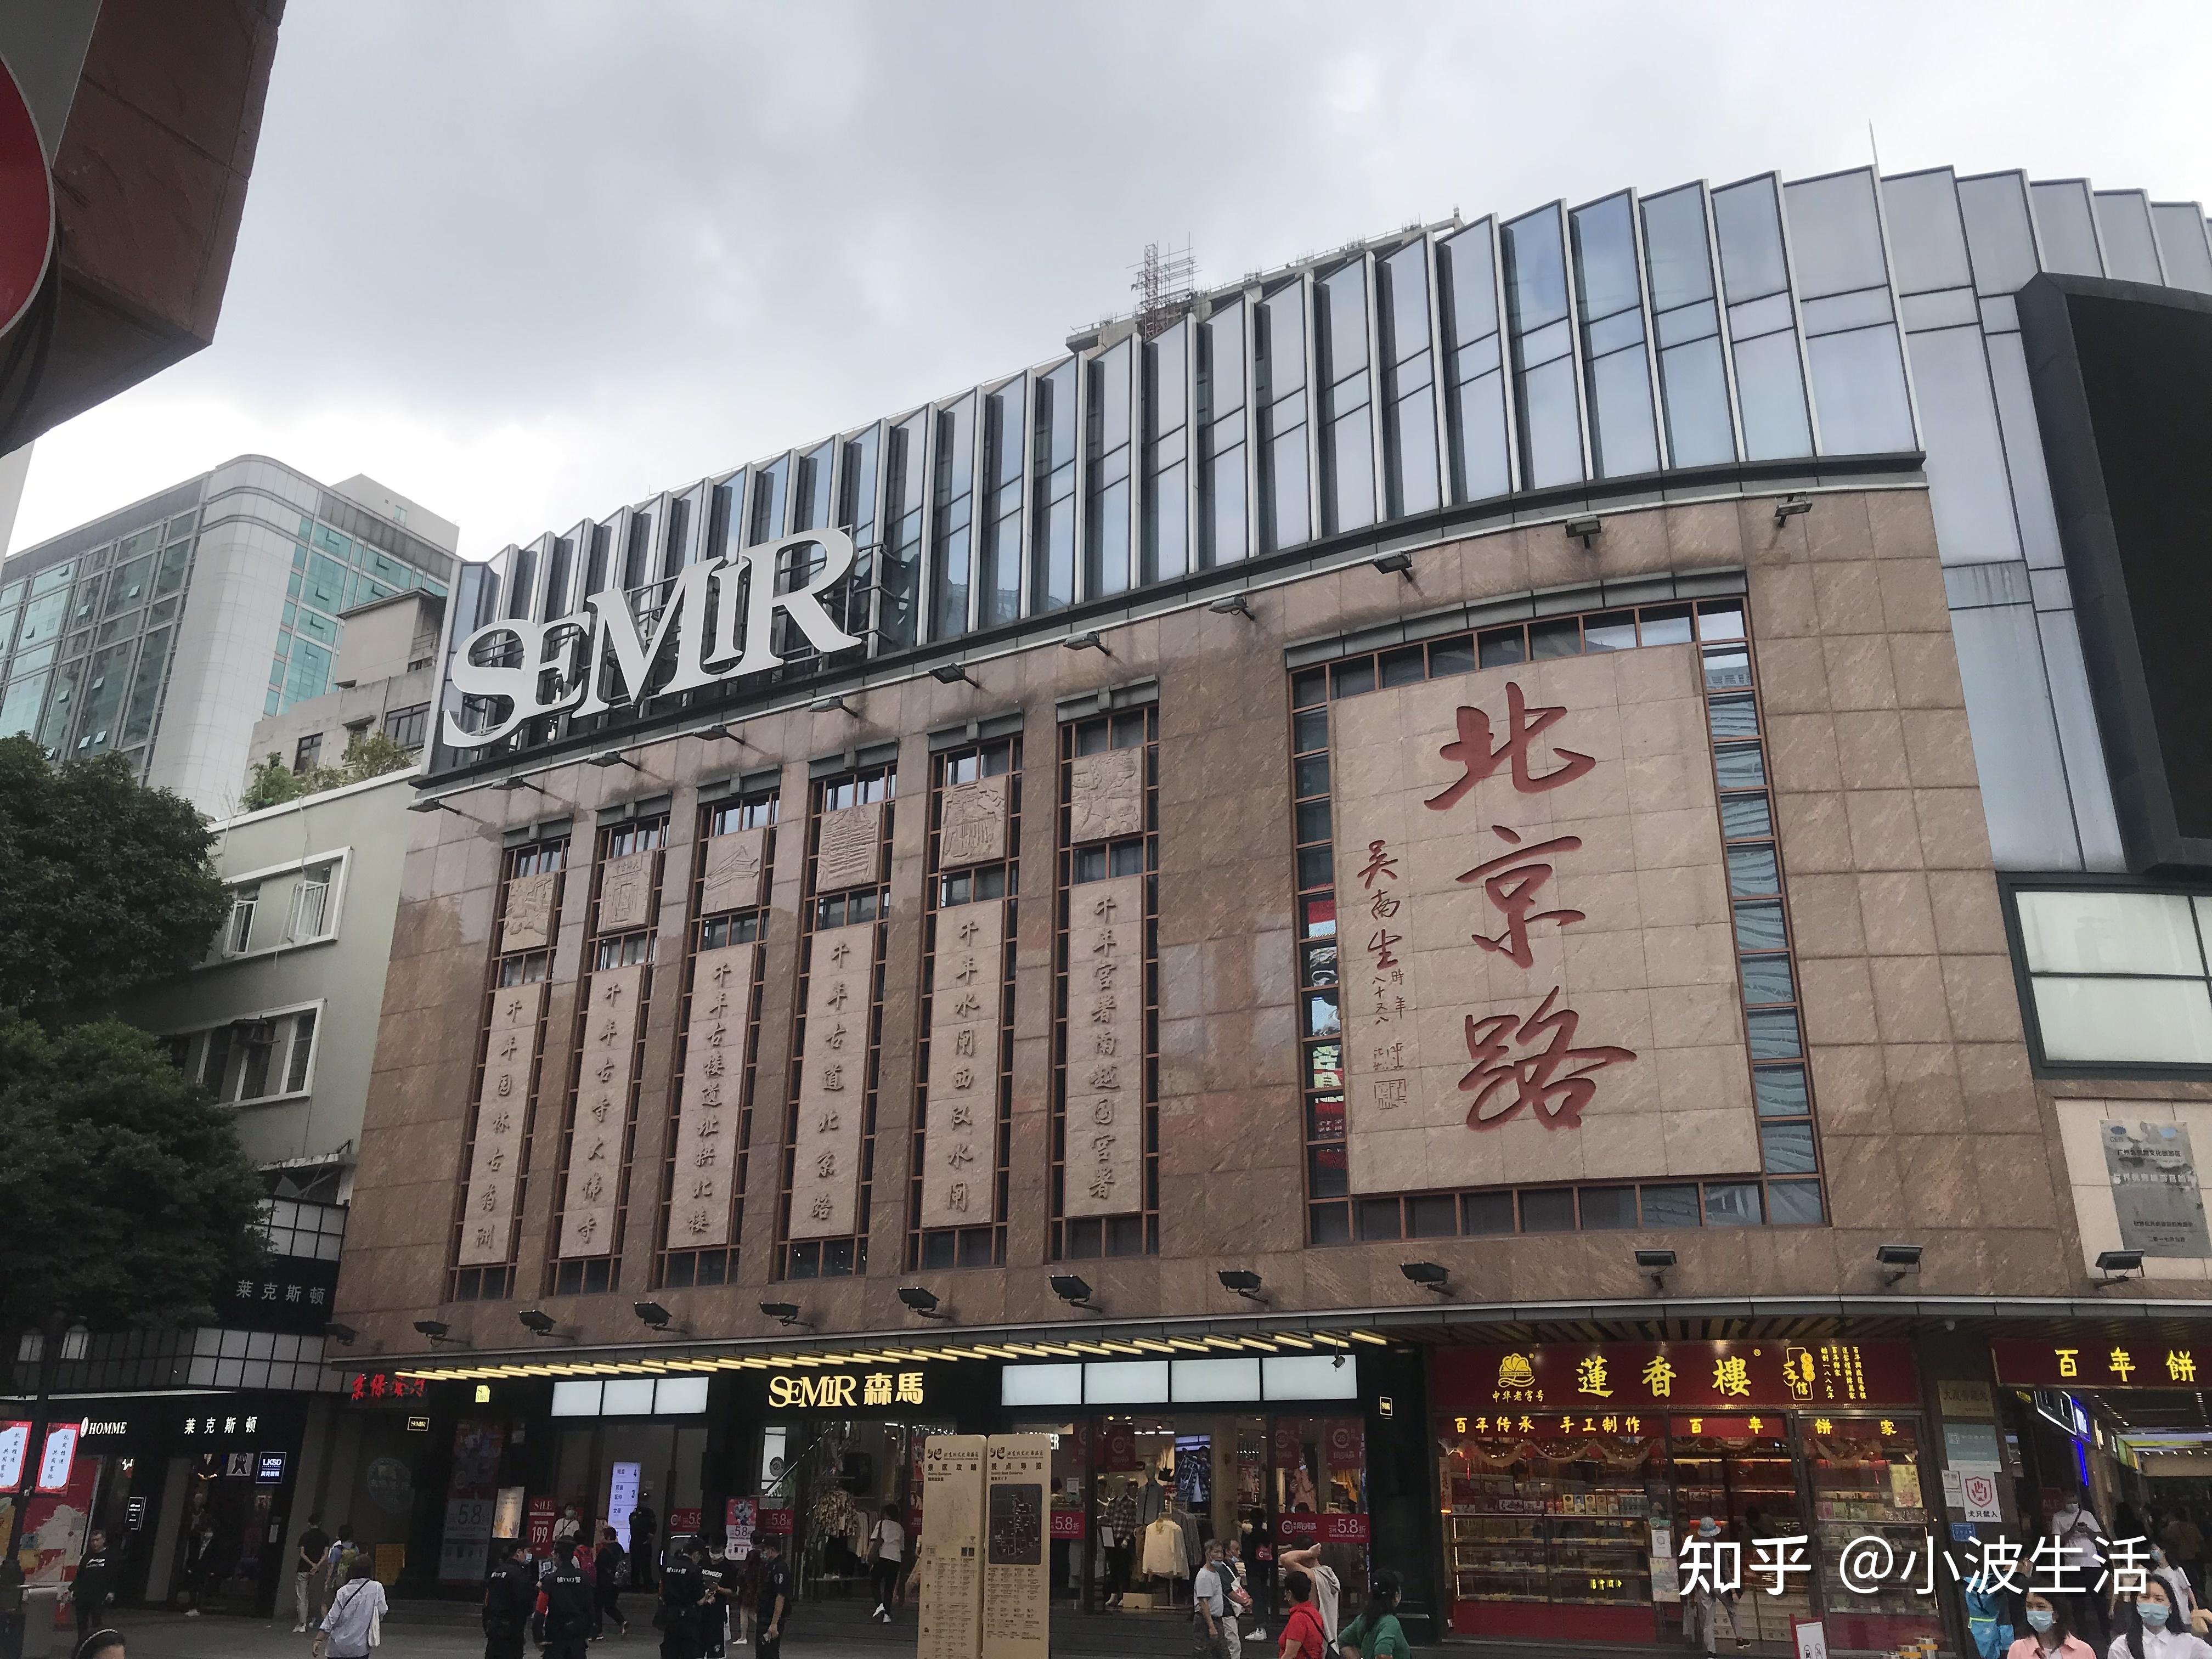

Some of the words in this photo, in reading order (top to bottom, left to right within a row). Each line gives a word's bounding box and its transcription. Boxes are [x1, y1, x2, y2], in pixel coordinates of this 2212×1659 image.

[443, 526, 862, 748] SEMIR
[1424, 681, 1637, 1132] 北京路
[1089, 898, 1121, 1200] 千年宫署南越国宫署
[811, 941, 850, 1220] 千年古道北京路
[577, 982, 622, 1245] 千年古寺大佛寺
[236, 1279, 325, 1305] 莱克斯顿
[1576, 1355, 1752, 1398] 蓮香樓
[2055, 1346, 2197, 1382] 百年餅
[769, 1375, 857, 1408] SEMIR
[863, 1372, 924, 1406] 森馬
[1492, 1390, 1544, 1404] 中华老字号
[88, 1421, 127, 1435] HOMME
[184, 1416, 258, 1435] 莱克斯顿
[1454, 1416, 1536, 1434] 百年传承
[1559, 1415, 1642, 1435] 手工制作
[262, 1458, 282, 1466] LKSD
[1968, 1510, 1998, 1518] 犬只禁入
